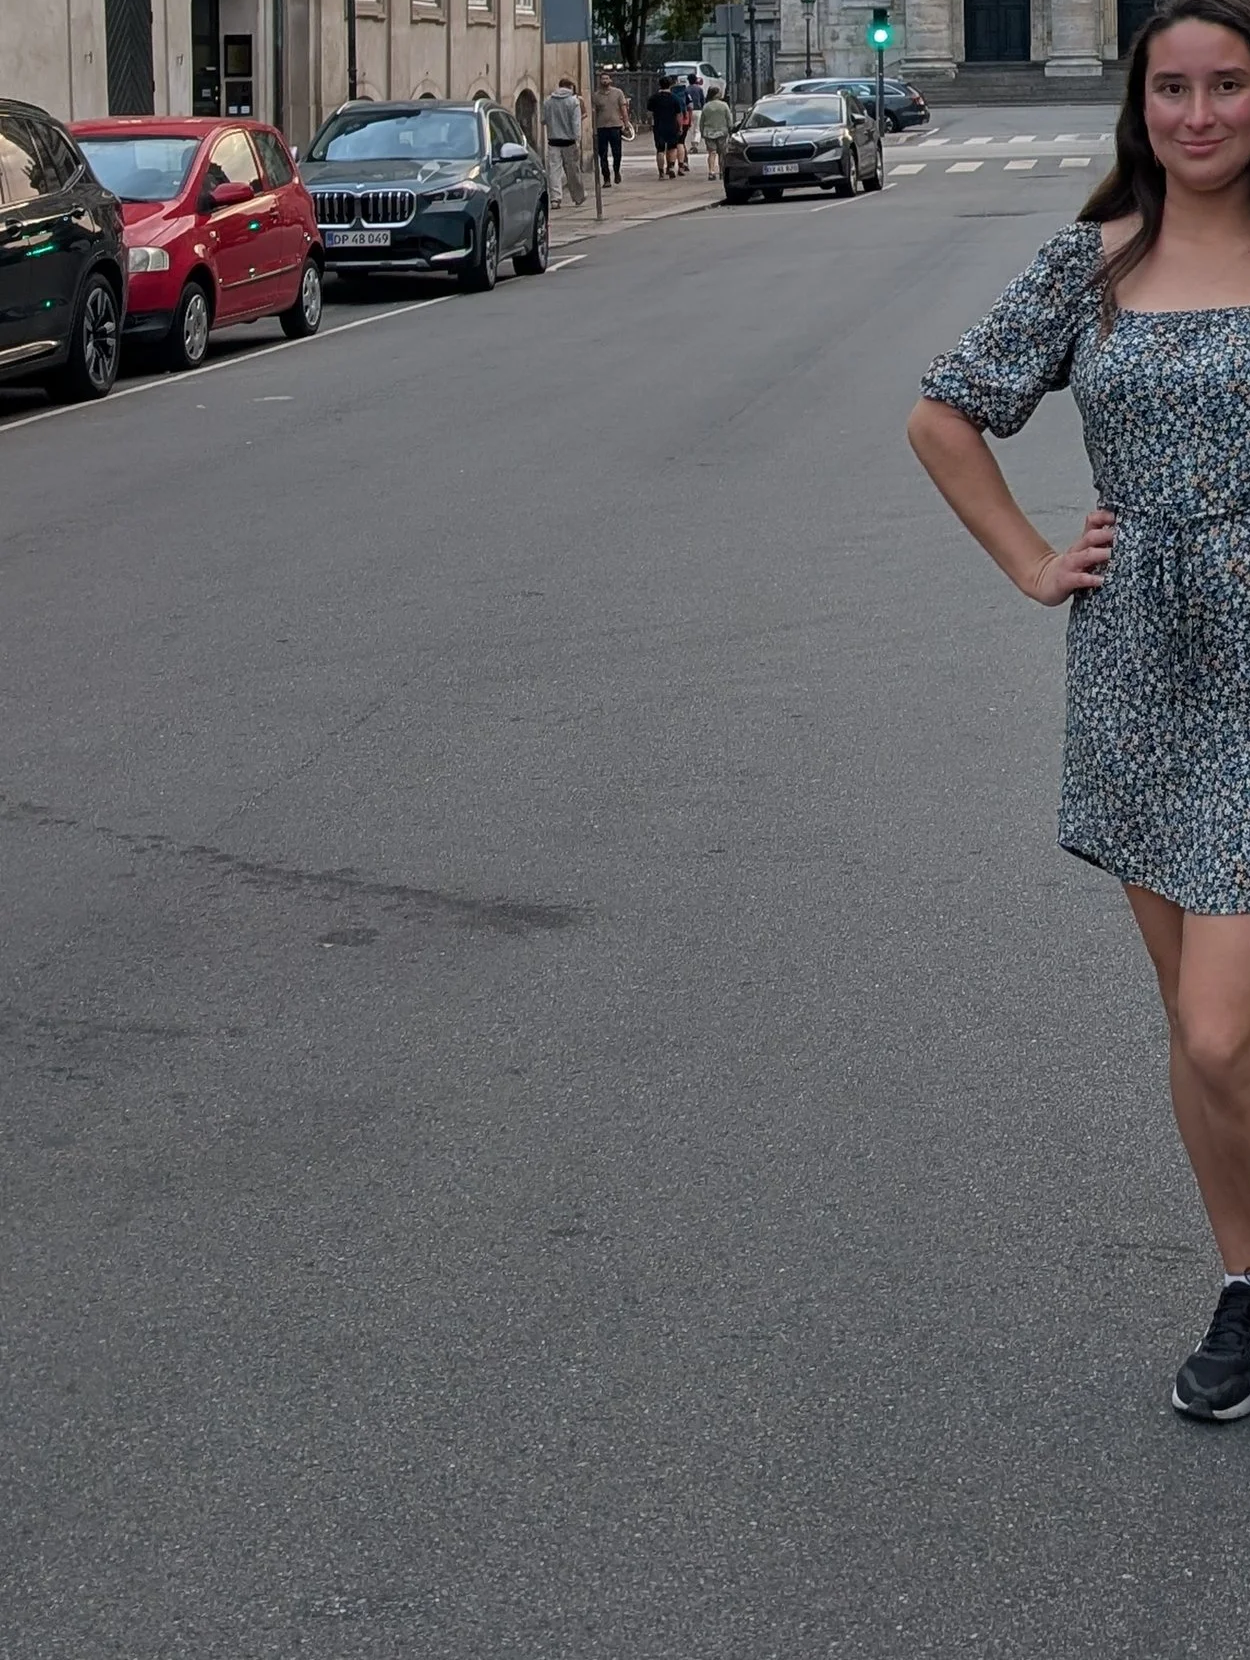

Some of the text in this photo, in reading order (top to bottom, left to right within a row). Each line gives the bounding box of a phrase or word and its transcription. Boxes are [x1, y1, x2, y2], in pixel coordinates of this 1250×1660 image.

[334, 232, 389, 245] DP 48 049
